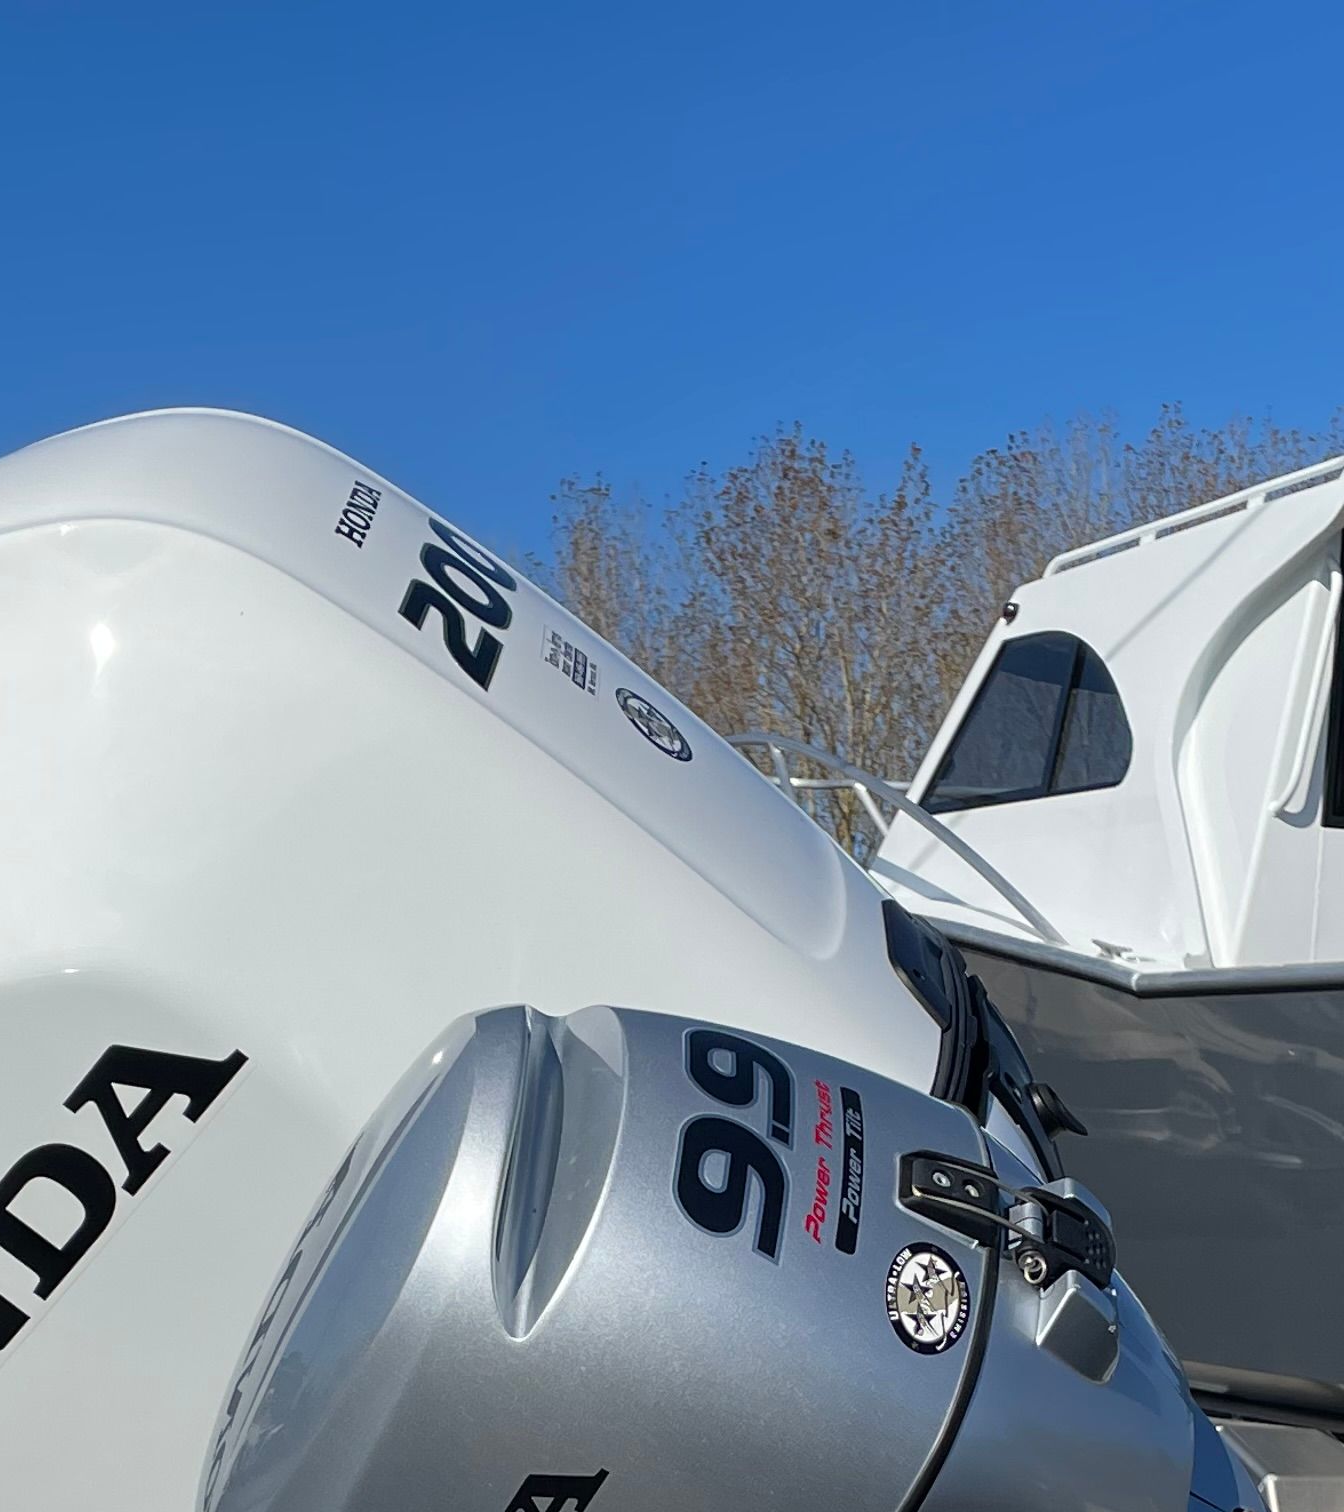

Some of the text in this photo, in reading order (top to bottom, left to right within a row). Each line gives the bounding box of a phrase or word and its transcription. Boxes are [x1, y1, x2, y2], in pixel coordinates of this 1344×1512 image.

[334, 480, 382, 548] HONDA
[804, 1079, 834, 1244] Power Thrust
[840, 1107, 863, 1225] Power Tilt
